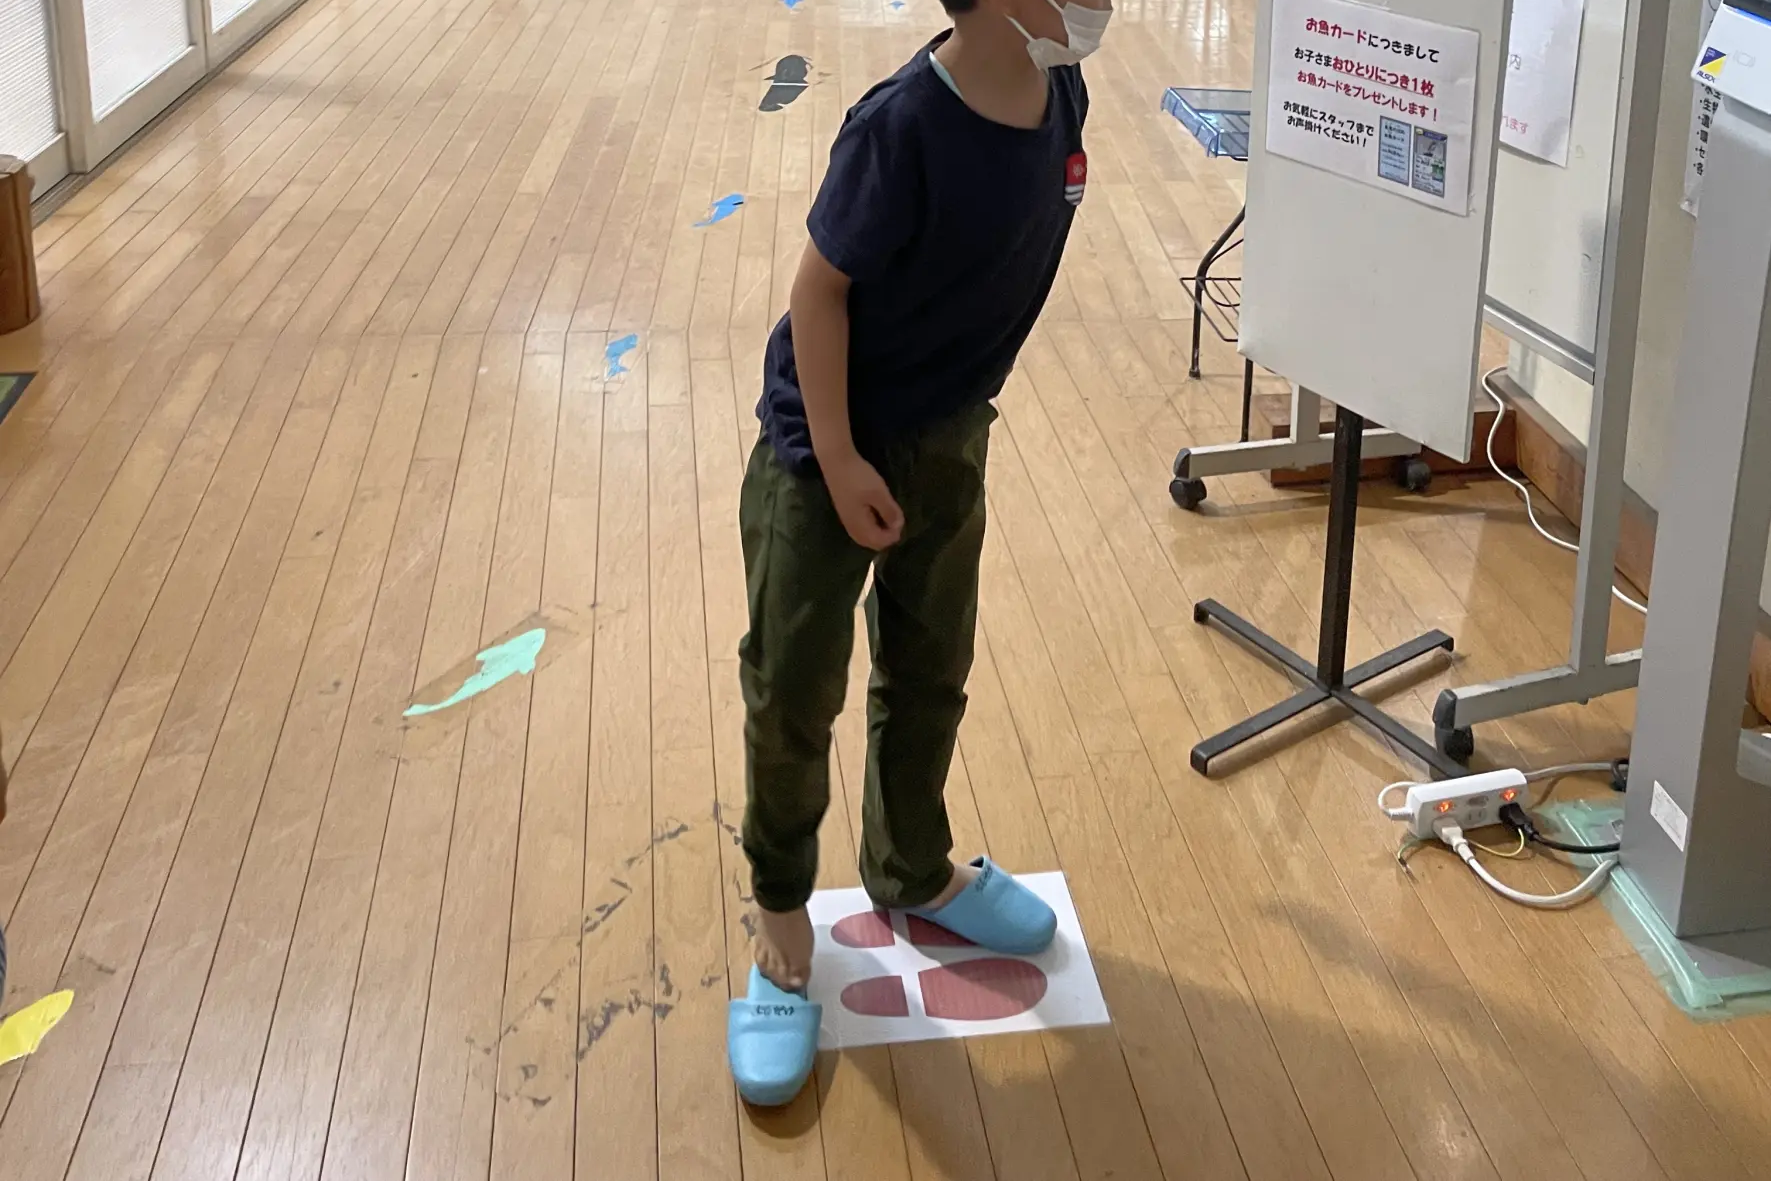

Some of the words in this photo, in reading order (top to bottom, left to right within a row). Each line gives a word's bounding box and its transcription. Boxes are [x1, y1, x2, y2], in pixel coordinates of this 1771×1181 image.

[1305, 16, 1441, 63] お魚カードにつきまして
[1293, 46, 1436, 98] お子さまおひとりにつき1枚
[1297, 70, 1439, 122] お魚カードをプレゼントします！
[1283, 100, 1375, 137] お気軽にスタッフまで
